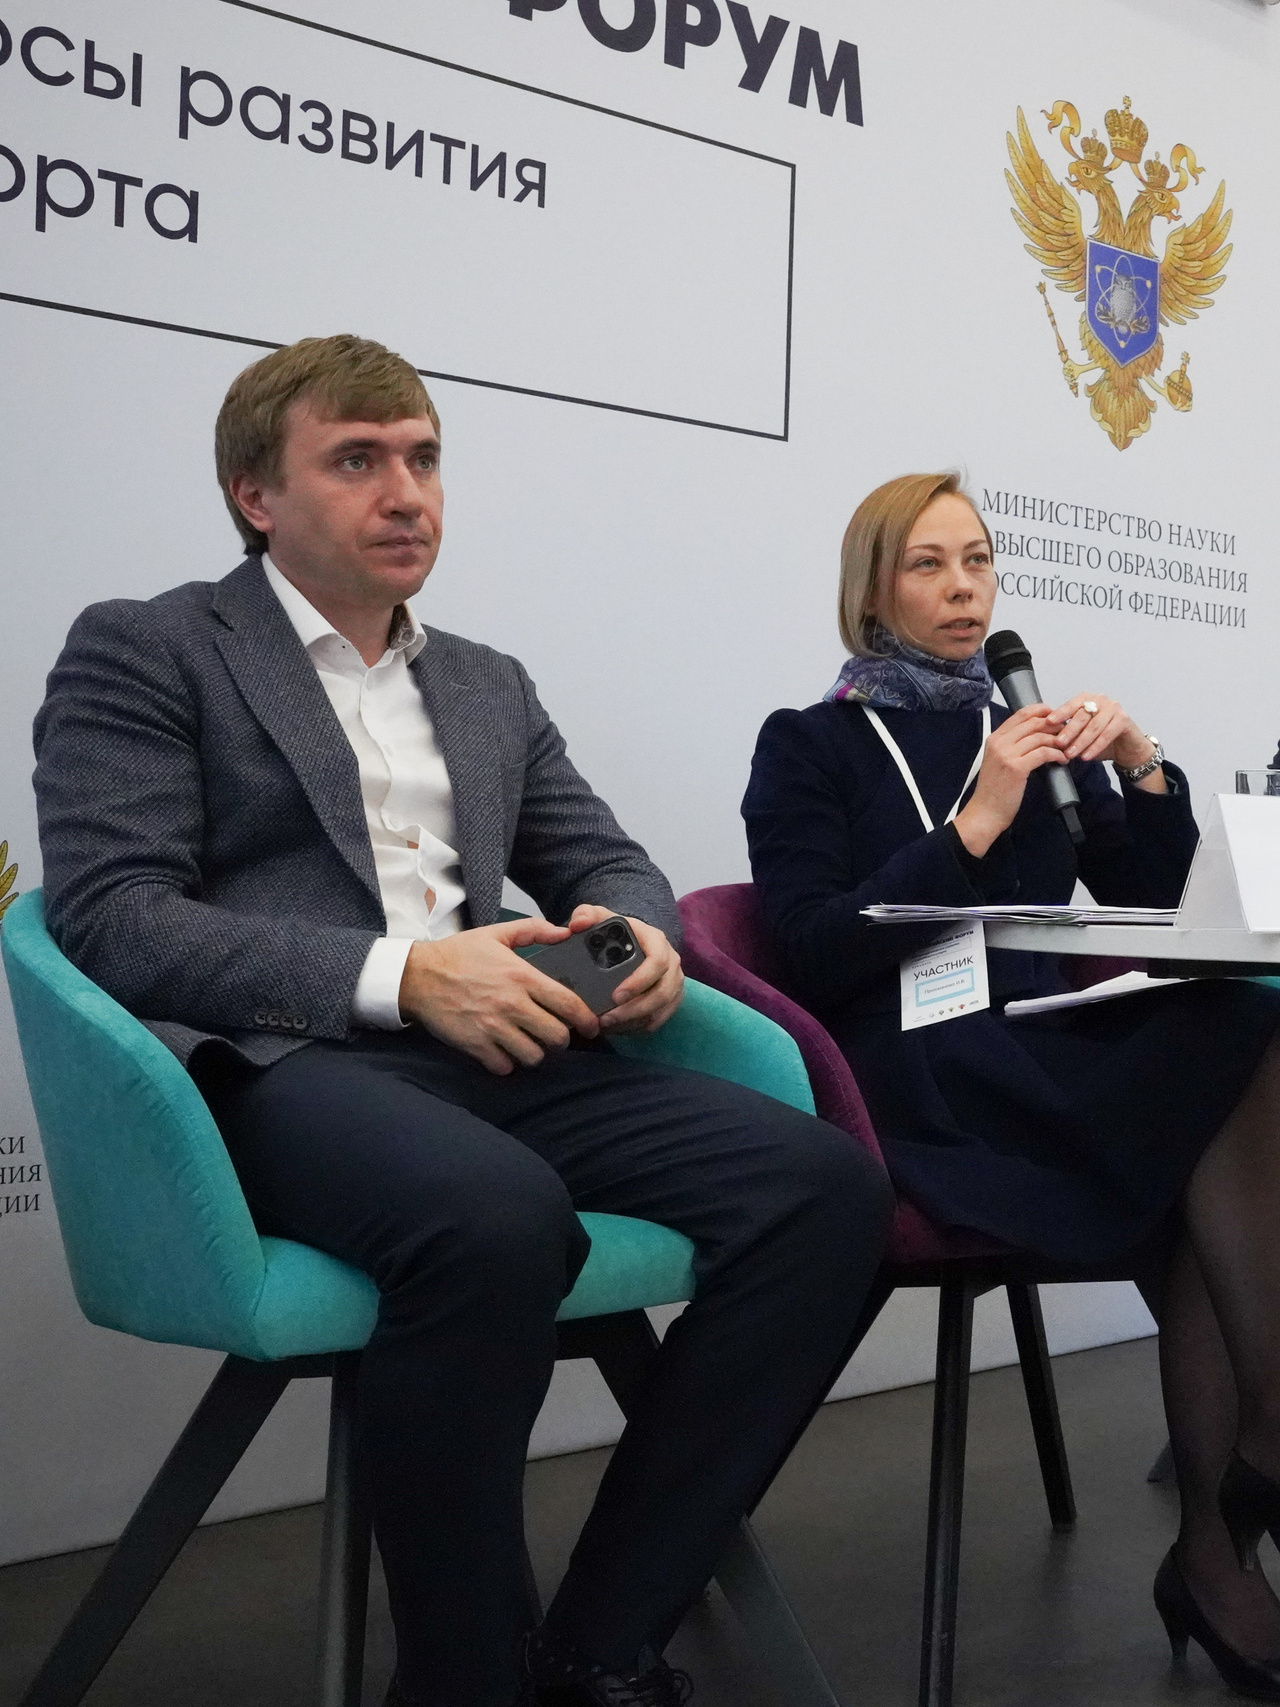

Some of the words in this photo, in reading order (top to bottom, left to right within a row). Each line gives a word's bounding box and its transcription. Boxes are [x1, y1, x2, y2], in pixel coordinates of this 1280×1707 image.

[0, 19, 143, 107] сы
[179, 65, 547, 209] развития
[982, 488, 1162, 542] МИНИСТЕРСТВО
[1168, 523, 1236, 556] НАУКИ
[994, 530, 1102, 570] ВЫСШЕГО
[1107, 550, 1249, 593] ОБРАЗОВАНИЯ
[1128, 591, 1247, 628] ФЕДЕРАЦИИ
[913, 955, 974, 981] УЧАСТНИК
